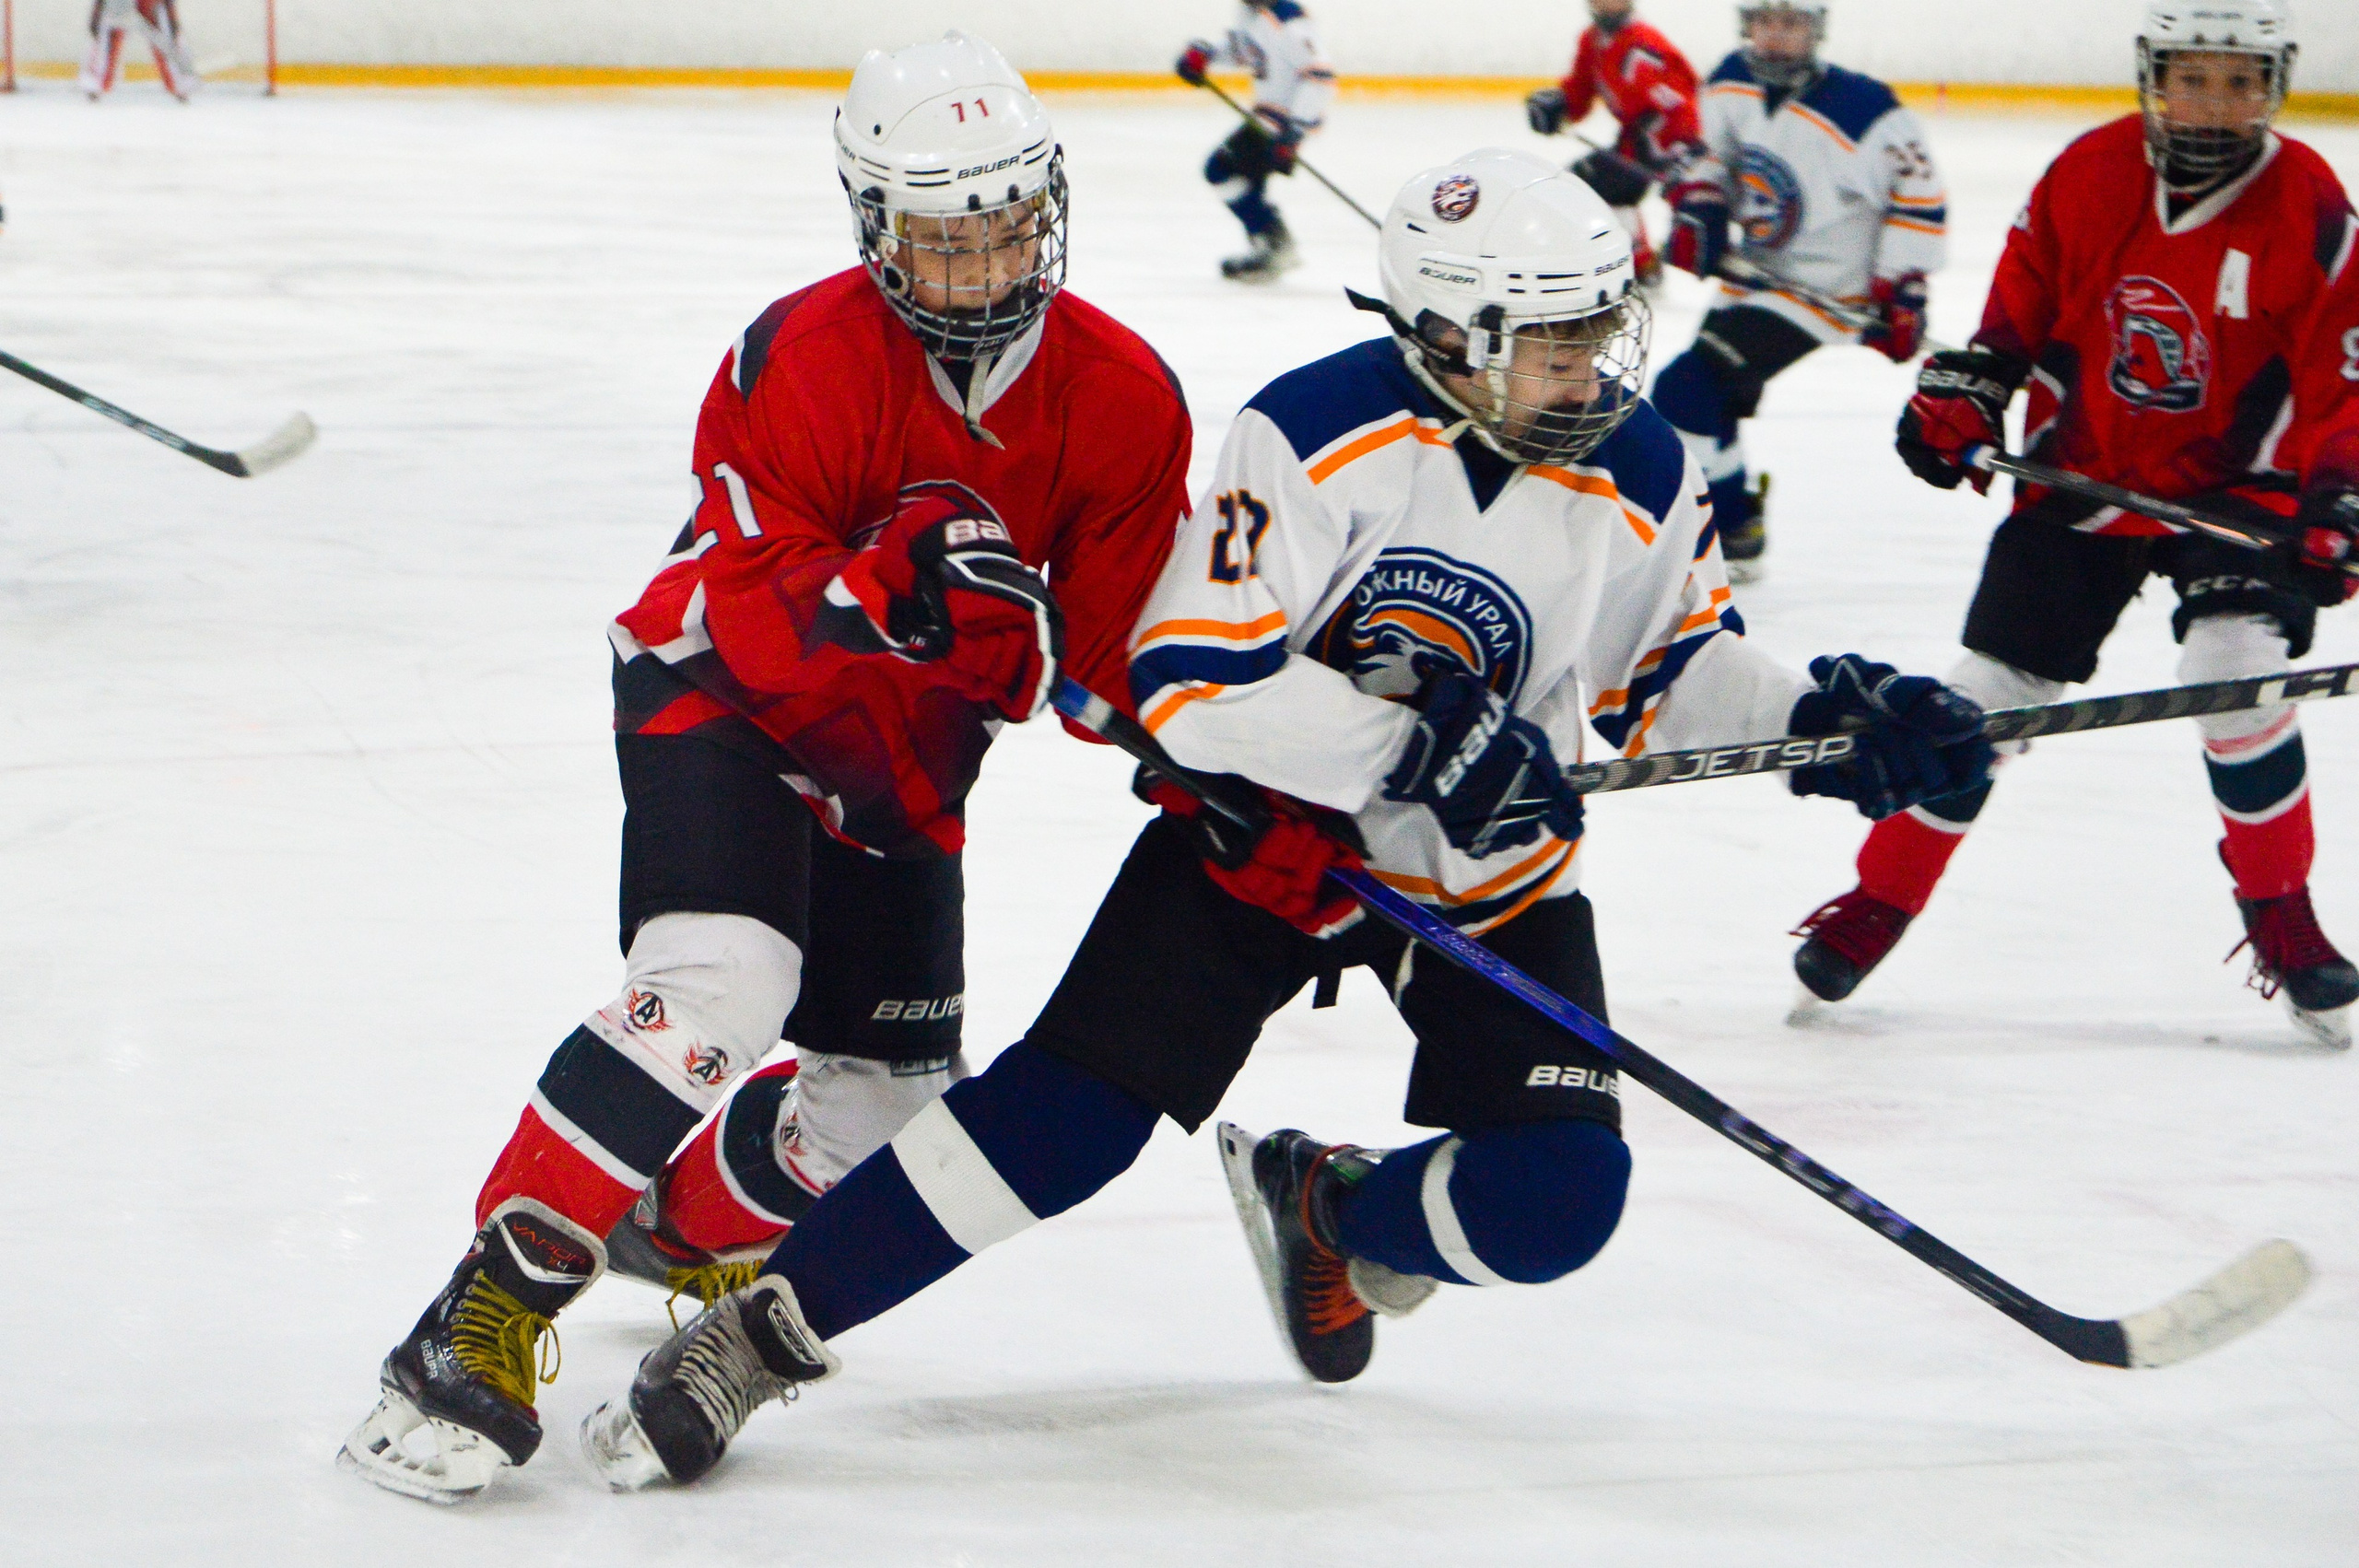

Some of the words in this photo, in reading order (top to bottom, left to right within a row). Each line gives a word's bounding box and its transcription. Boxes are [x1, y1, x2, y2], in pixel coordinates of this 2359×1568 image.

[950, 98, 990, 123] 71
[957, 155, 1020, 180] BAUER
[2212, 247, 2252, 320] A
[1464, 593, 1514, 660] УРАЛ
[1668, 736, 1855, 781] JETSP
